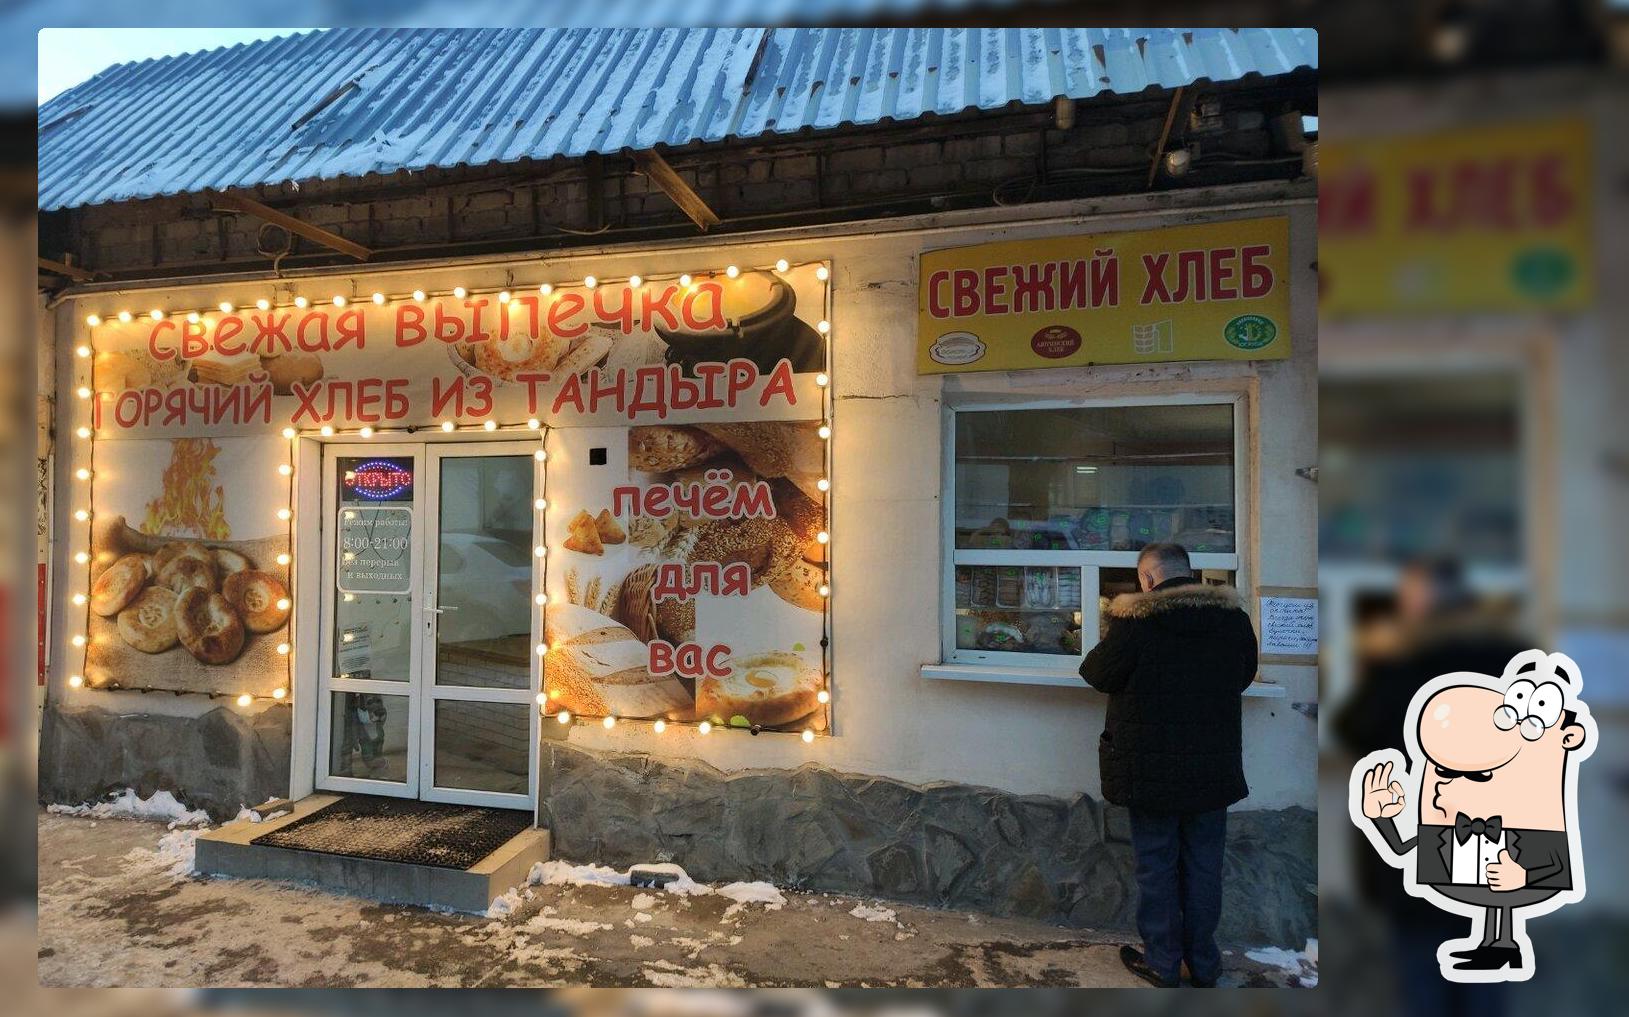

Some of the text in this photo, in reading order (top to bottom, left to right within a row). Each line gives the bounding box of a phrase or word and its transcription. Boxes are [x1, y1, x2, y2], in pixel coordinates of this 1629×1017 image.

[928, 245, 1275, 319] СВЕЖИЙ ХЛЕБ
[148, 282, 729, 361] свежая выпечка
[94, 358, 797, 430] ГОРЯЧИЙ ХЛЕБ ИЗ ТАНДЫРА
[613, 471, 775, 517] печём
[343, 537, 408, 550] 8:00-21:00
[654, 564, 749, 600] для
[649, 643, 732, 677] вас
